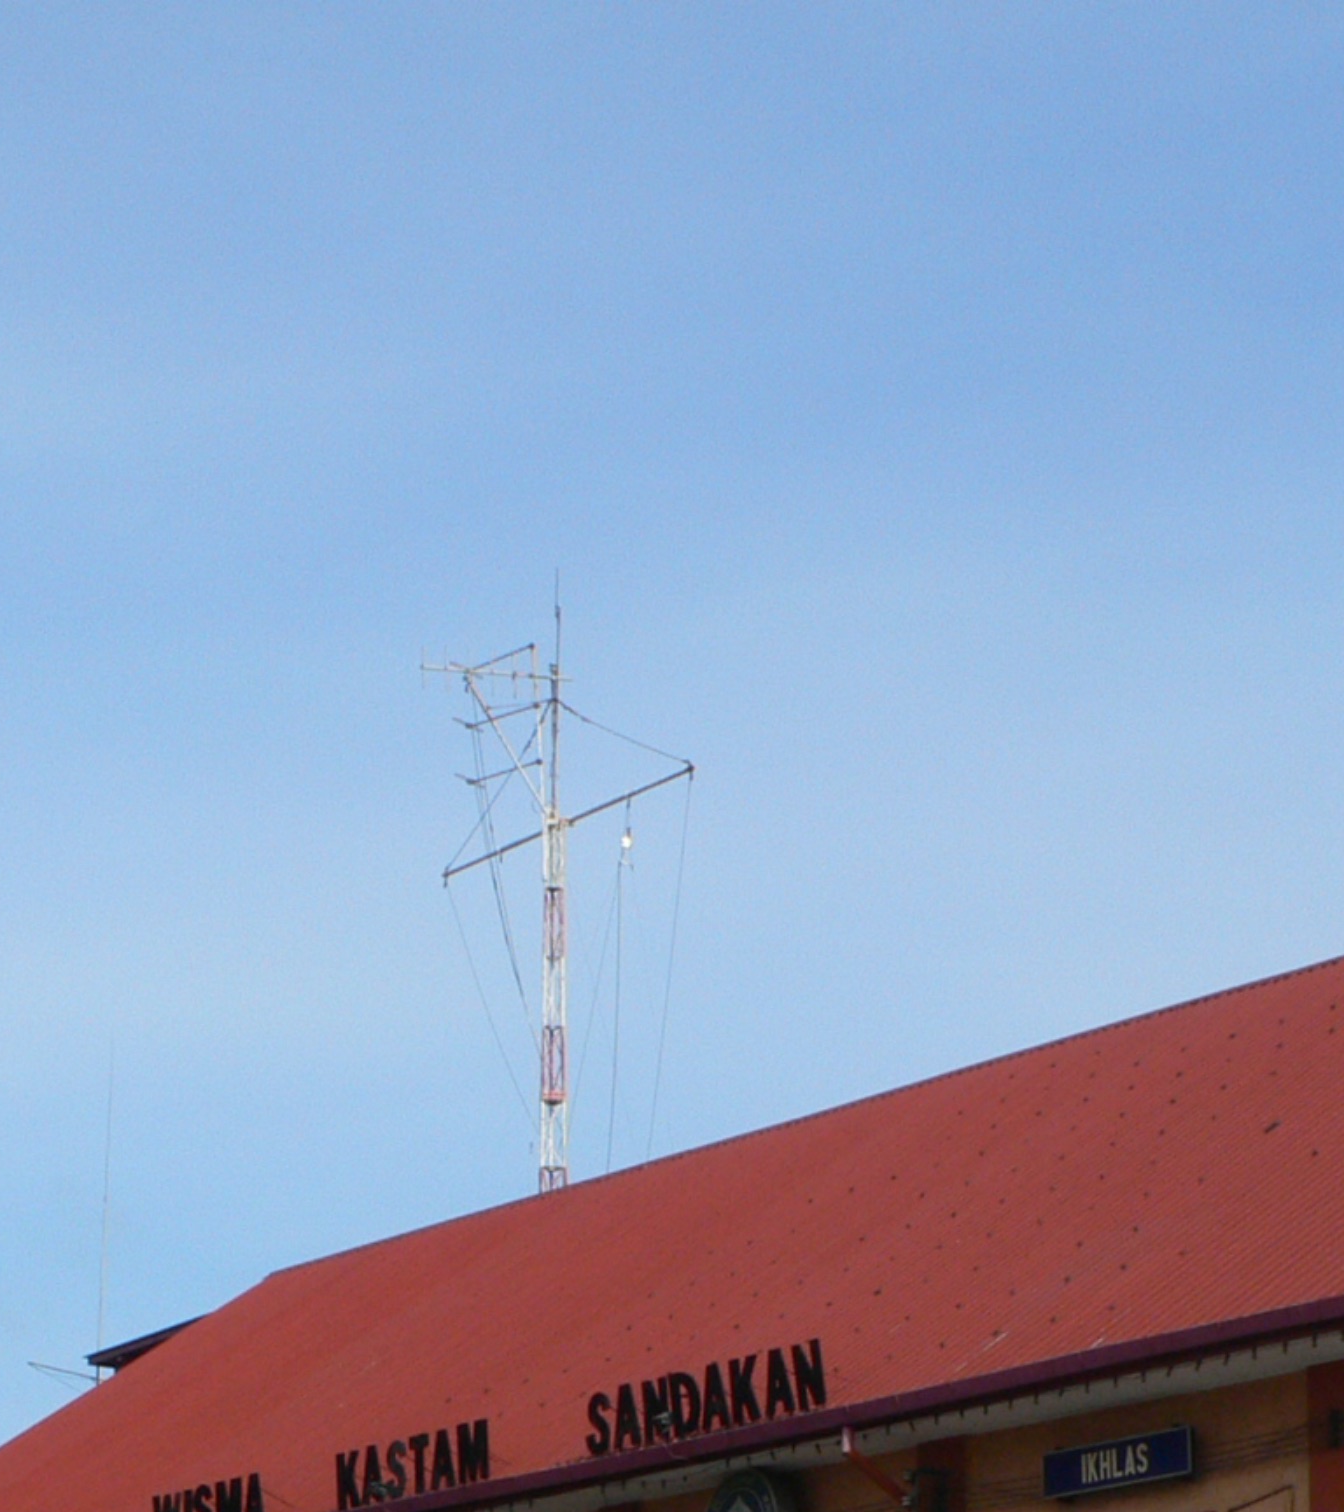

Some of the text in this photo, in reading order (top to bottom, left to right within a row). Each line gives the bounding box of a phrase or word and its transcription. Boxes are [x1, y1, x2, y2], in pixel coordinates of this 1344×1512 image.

[335, 1418, 490, 1511] KASTAM
[584, 1338, 827, 1455] SANDAKAN
[1080, 1442, 1149, 1485] IKHLAS
